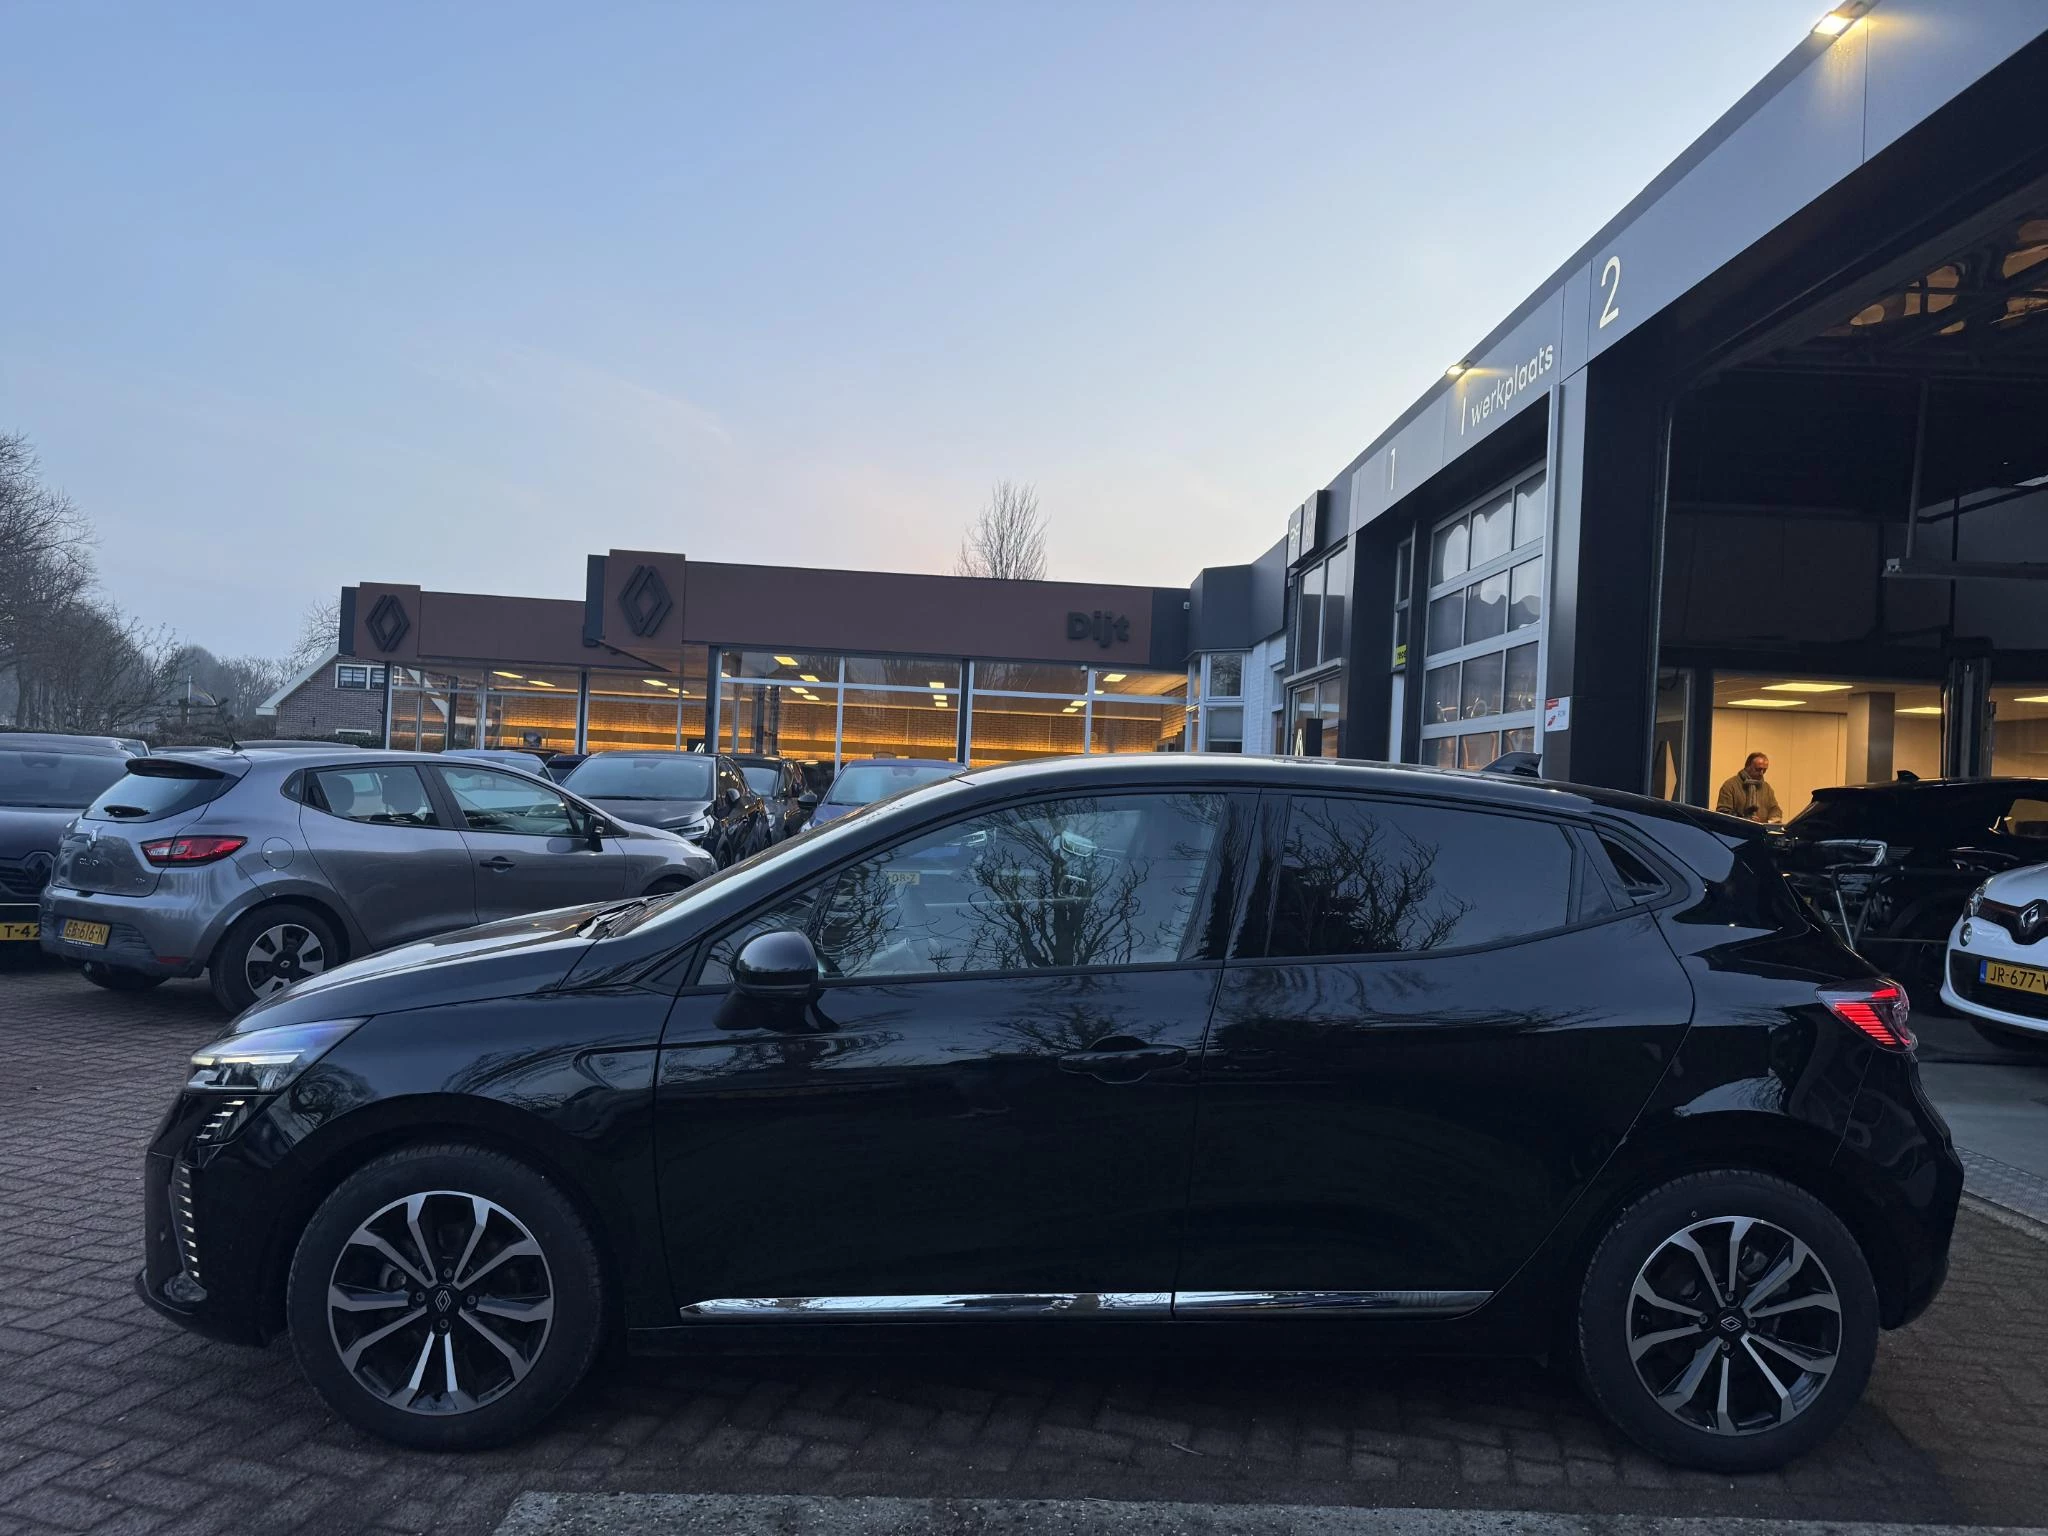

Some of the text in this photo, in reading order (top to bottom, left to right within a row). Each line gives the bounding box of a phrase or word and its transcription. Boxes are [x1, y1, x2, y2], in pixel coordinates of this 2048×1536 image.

[1599, 255, 1621, 329] 2
[1470, 344, 1554, 428] werkplaats
[1390, 447, 1396, 491] 1
[1067, 610, 1129, 649] Dijt
